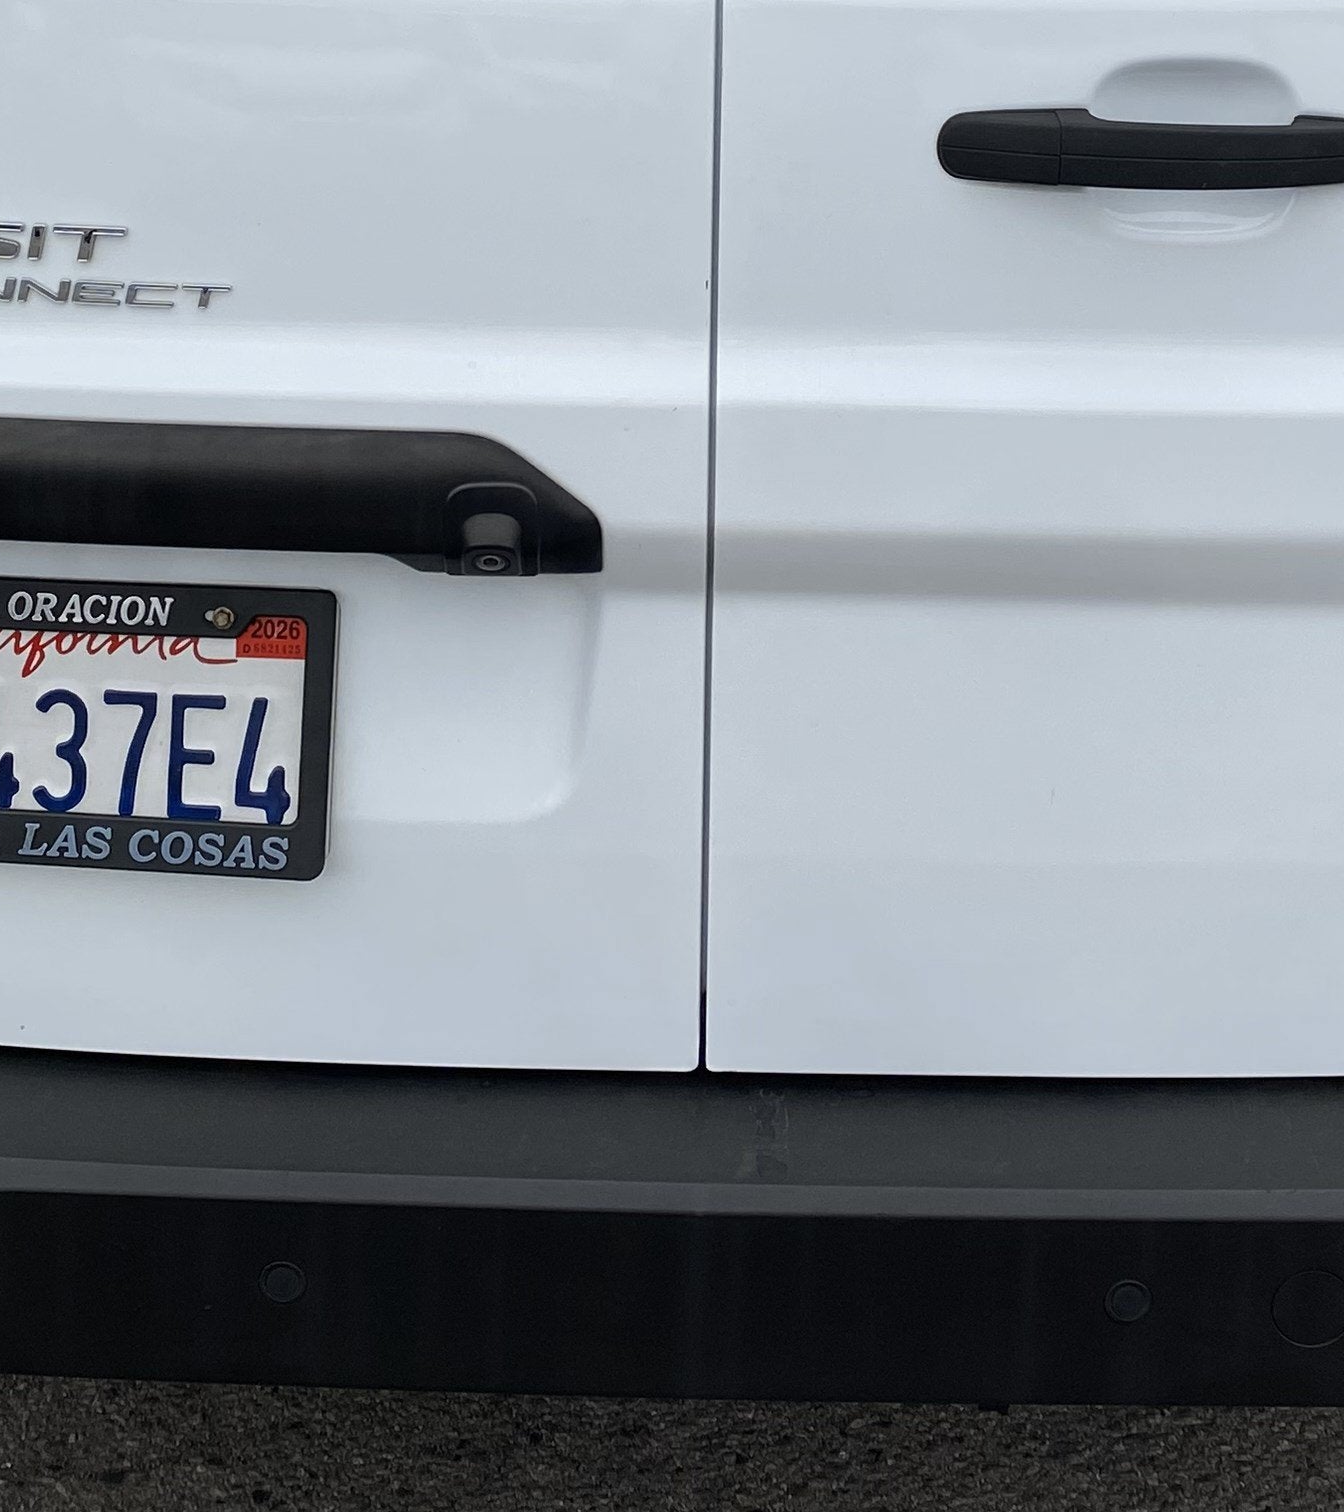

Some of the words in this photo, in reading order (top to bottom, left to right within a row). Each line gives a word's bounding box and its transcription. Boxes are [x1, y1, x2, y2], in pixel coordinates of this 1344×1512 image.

[7, 591, 174, 626] ORACION
[251, 619, 301, 640] 2026
[17, 822, 113, 860] LAS
[128, 829, 290, 870] COSAS
